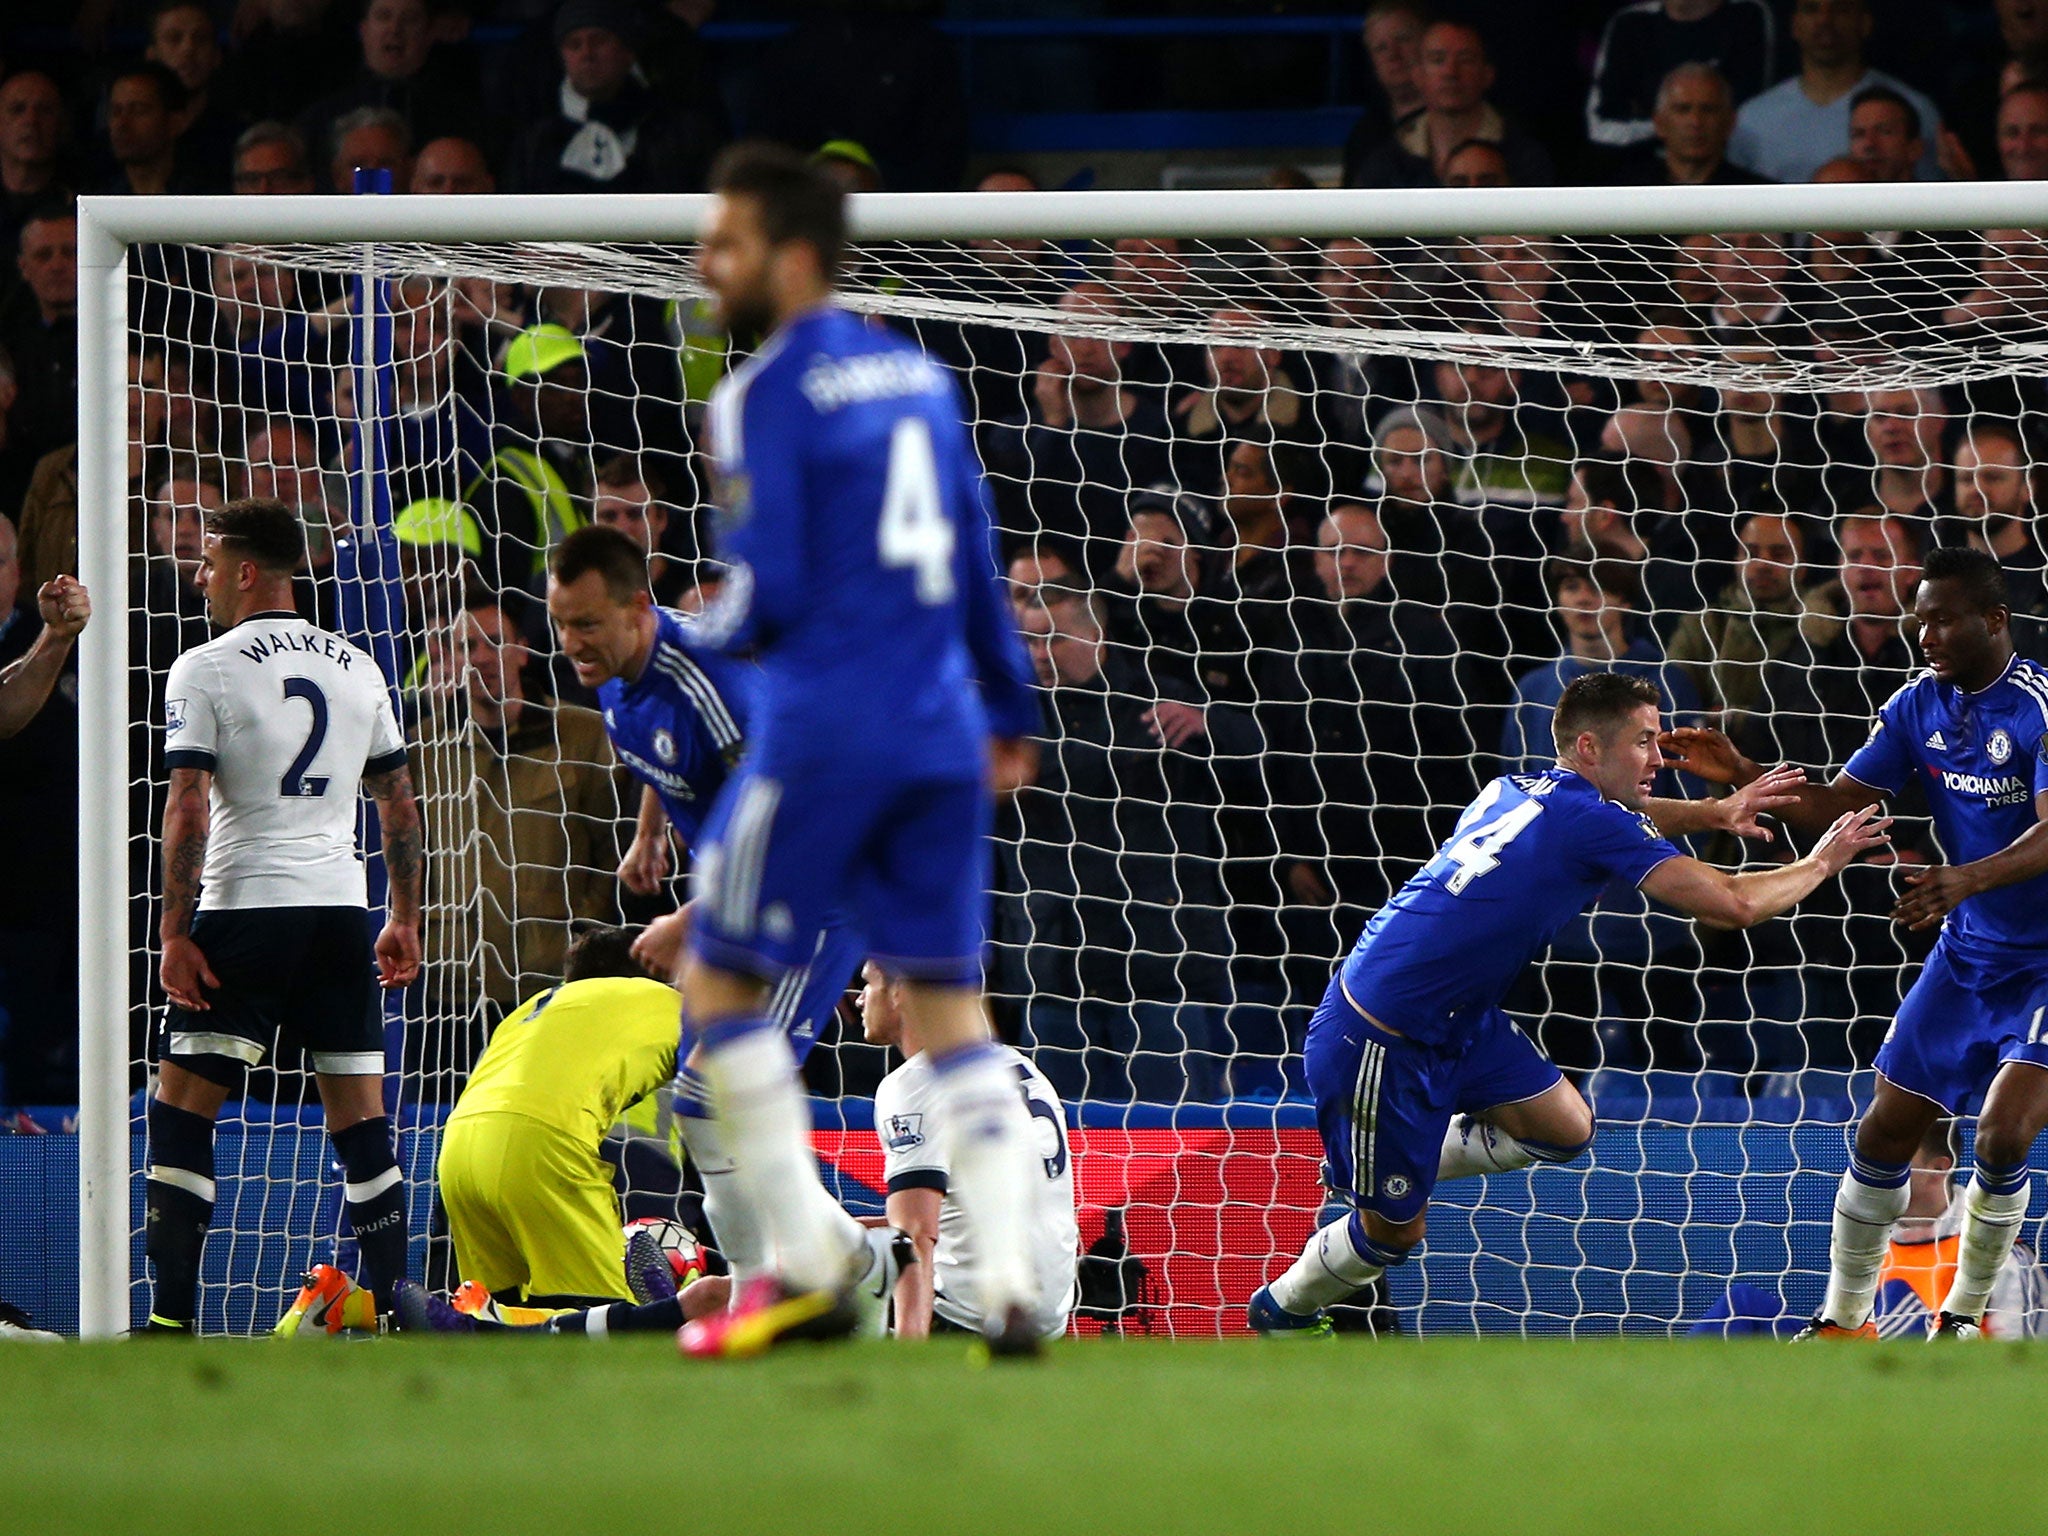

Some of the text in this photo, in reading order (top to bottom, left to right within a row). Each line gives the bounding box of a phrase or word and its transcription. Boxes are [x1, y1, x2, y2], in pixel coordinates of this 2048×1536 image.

[878, 414, 956, 606] 4
[239, 631, 352, 671] WALKER
[280, 674, 331, 798] 2
[1942, 771, 2026, 795] YOKOHAMA
[1985, 790, 2028, 808] TYRES
